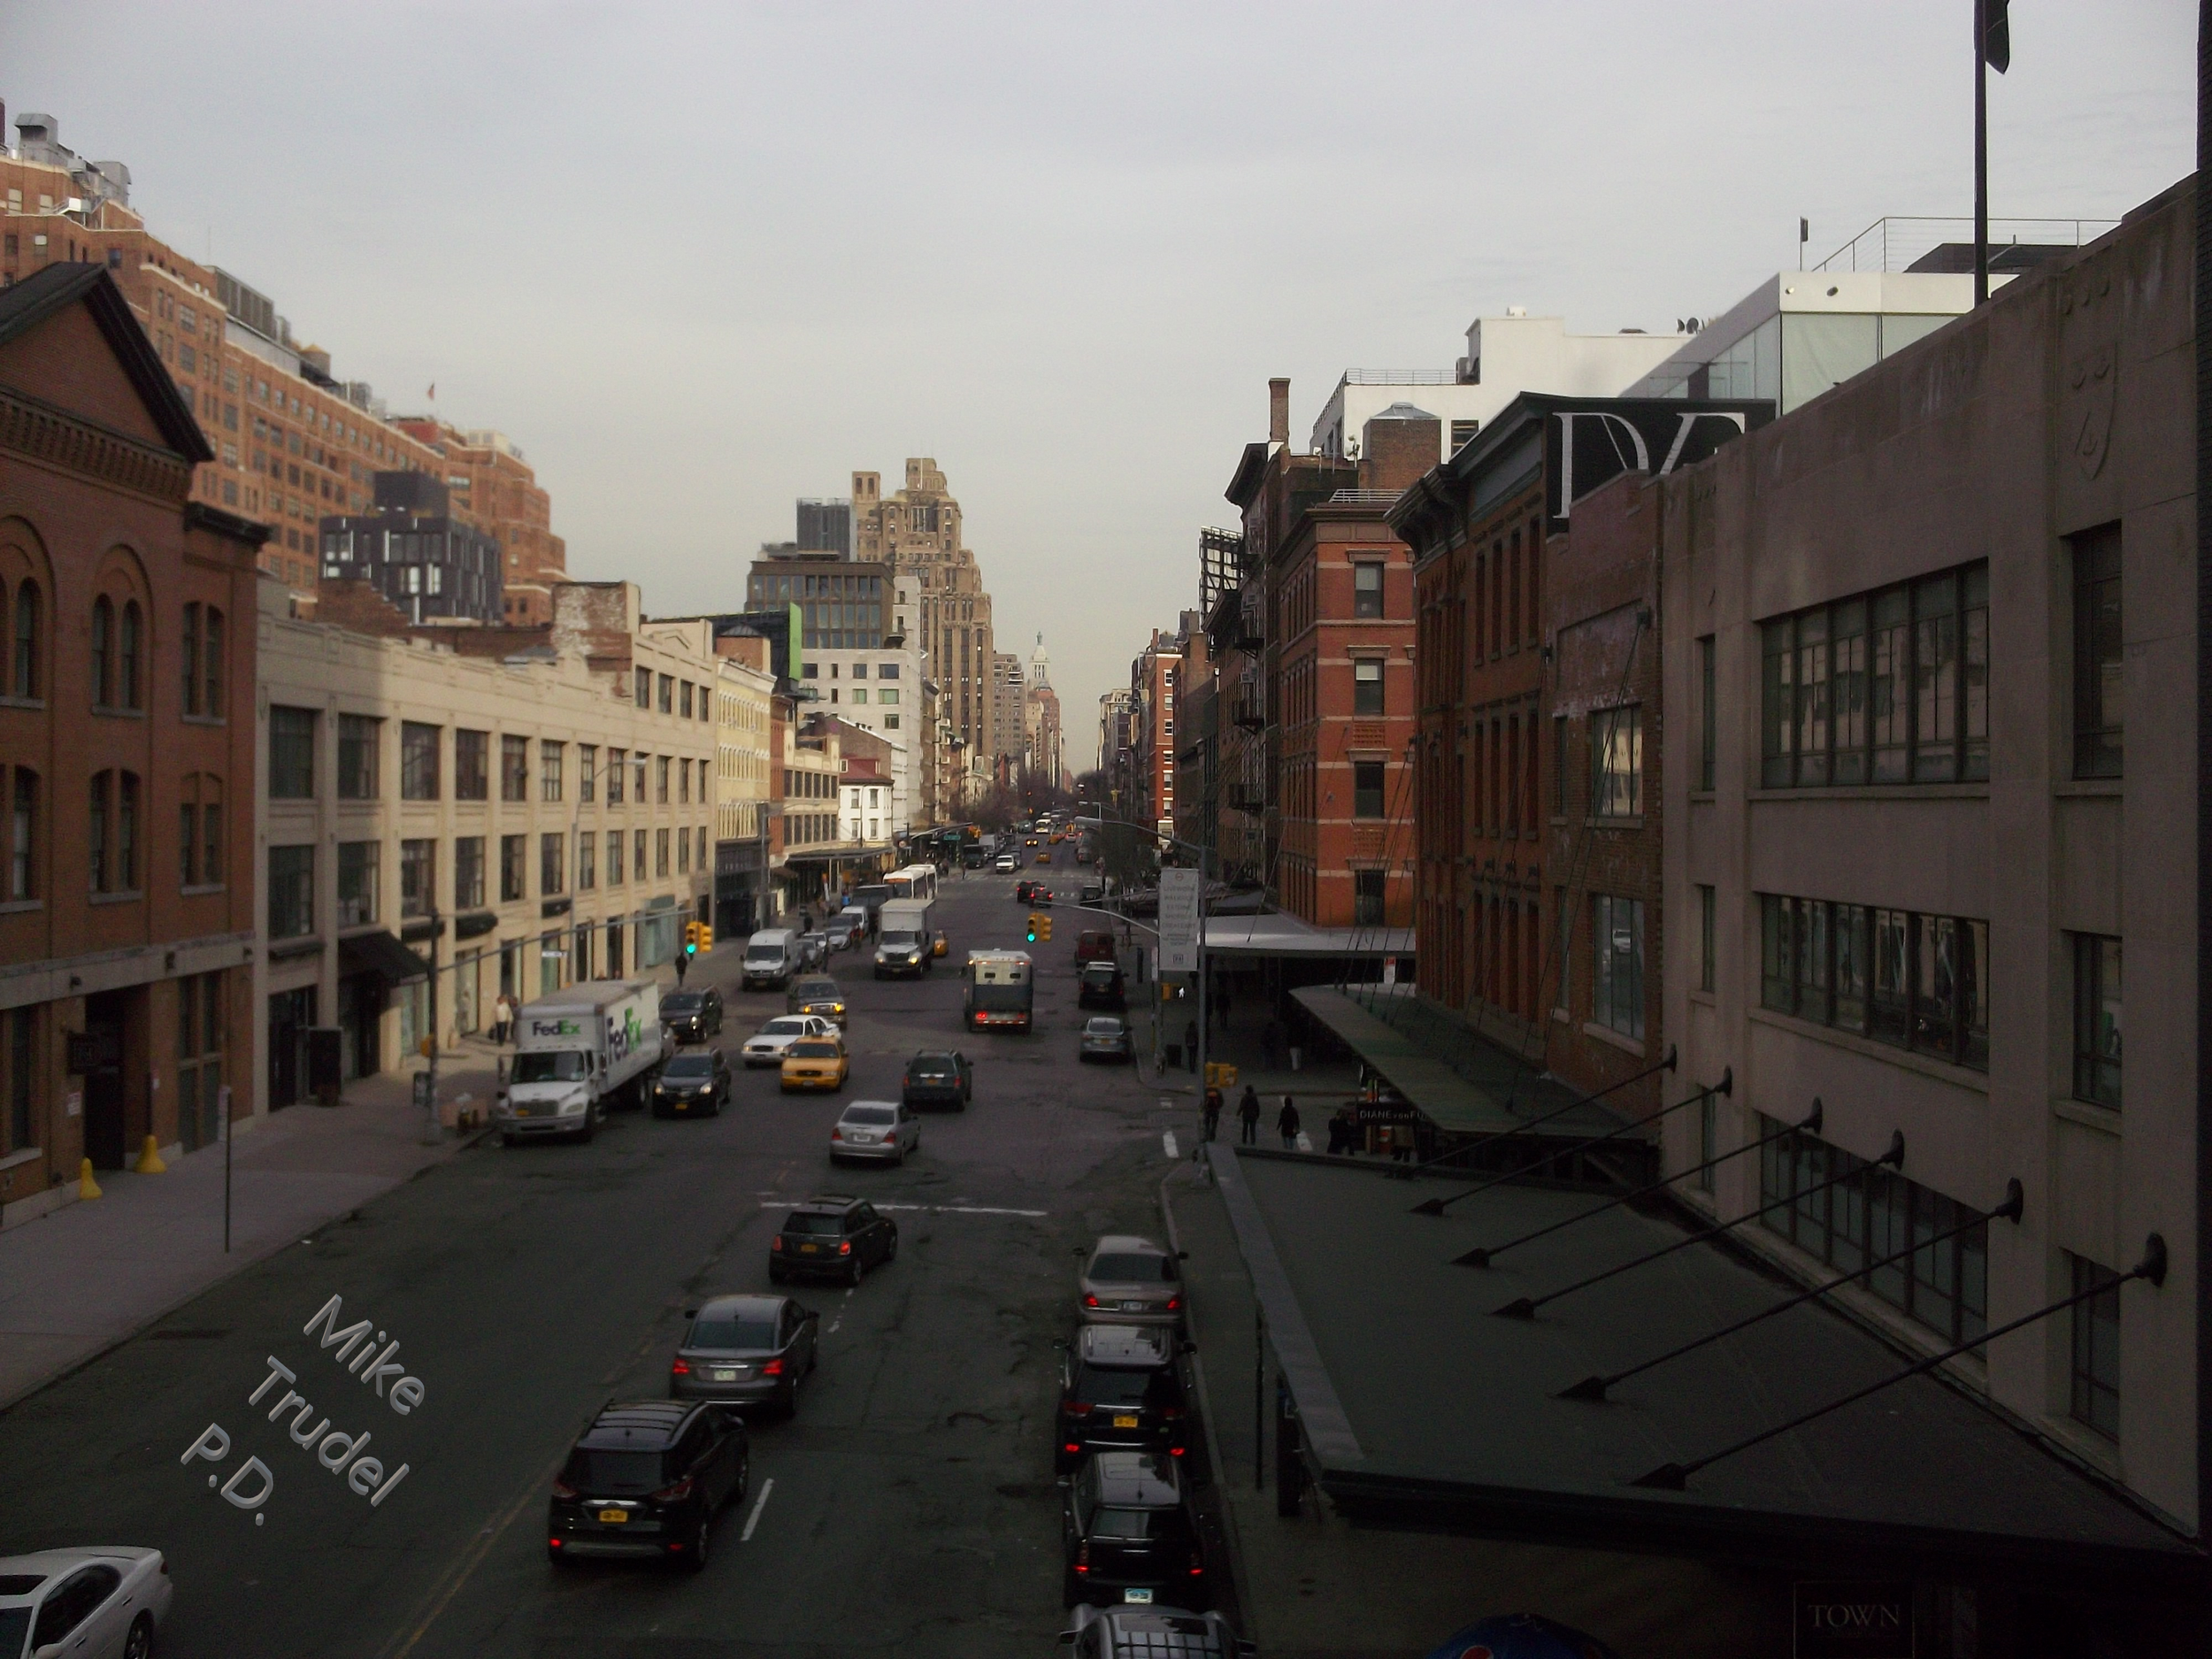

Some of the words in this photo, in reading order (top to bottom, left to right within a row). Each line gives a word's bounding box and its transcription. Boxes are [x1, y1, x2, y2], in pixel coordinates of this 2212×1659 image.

[533, 1019, 580, 1036] FedEx
[1360, 1110, 1392, 1119] DIANE
[1807, 1604, 1900, 1628] TOWN
